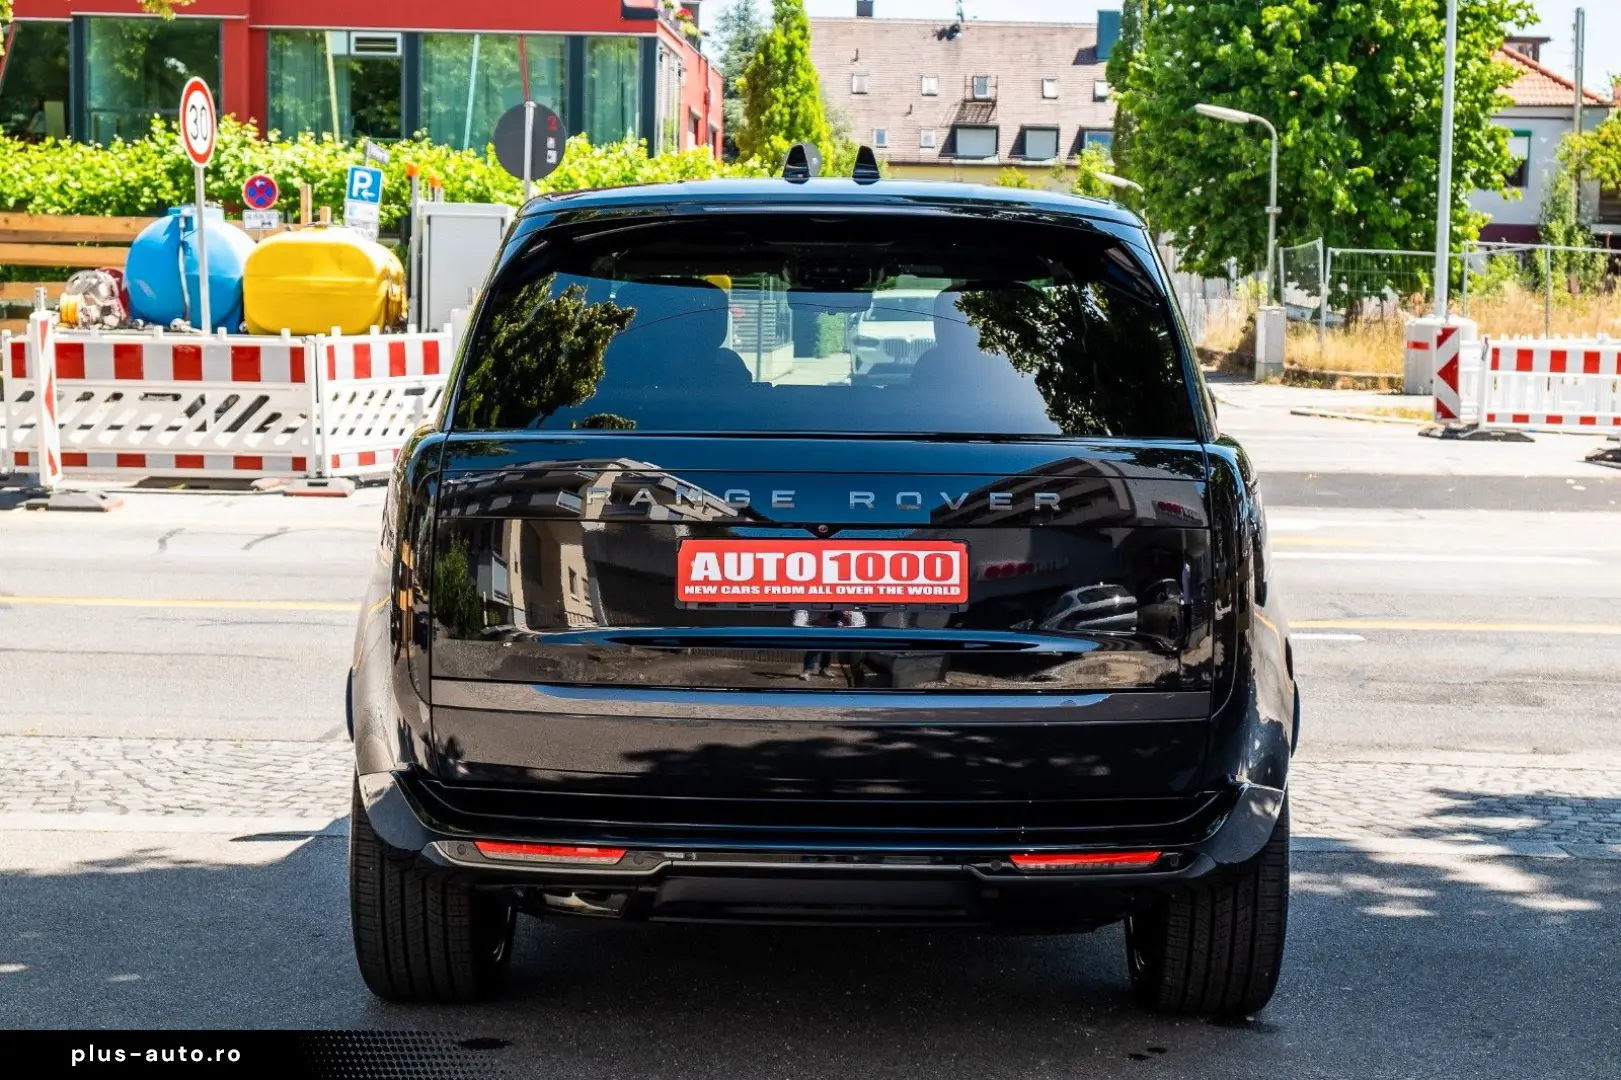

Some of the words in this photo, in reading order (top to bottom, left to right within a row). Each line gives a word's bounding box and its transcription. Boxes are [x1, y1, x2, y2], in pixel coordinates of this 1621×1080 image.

[188, 104, 208, 142] 30
[352, 170, 373, 198] P
[585, 487, 796, 509] RANGE
[849, 490, 1062, 511] ROVER
[684, 585, 717, 595] NEW
[720, 585, 760, 595] CARS
[764, 585, 805, 595] FROM
[808, 585, 832, 595] ALL
[836, 585, 874, 595] OVER
[878, 585, 905, 595] THE
[907, 585, 960, 595] WORLD
